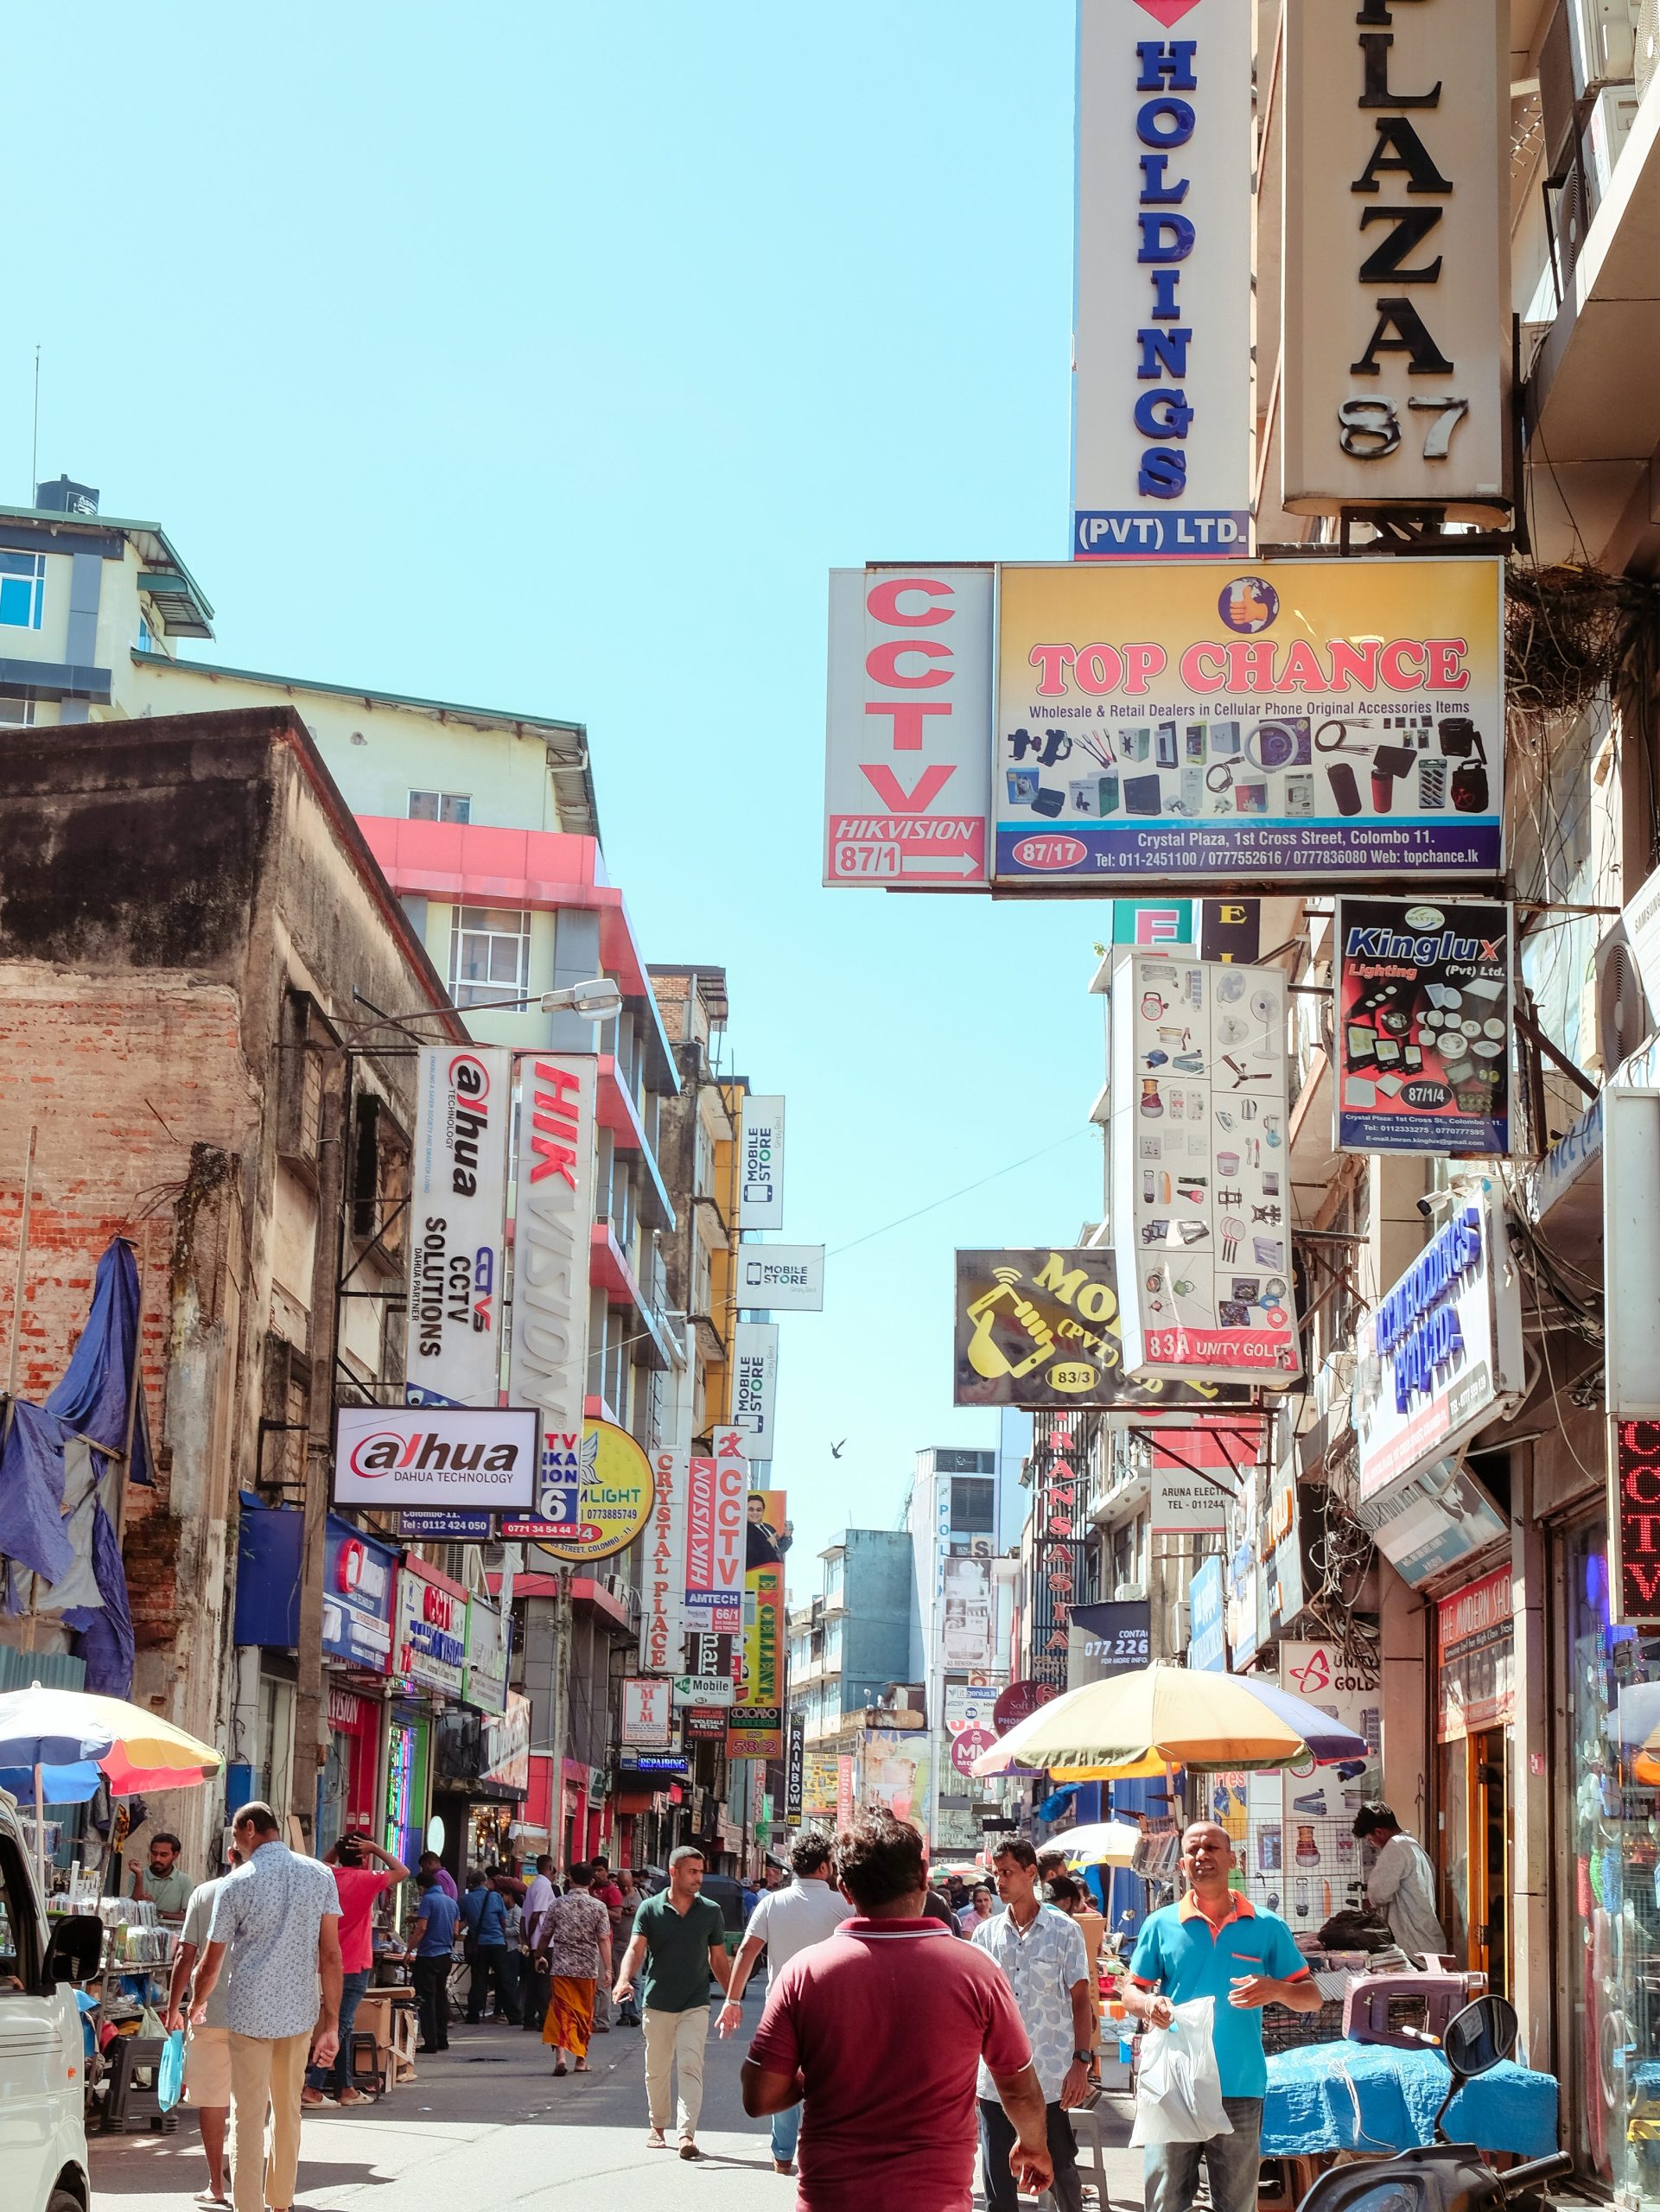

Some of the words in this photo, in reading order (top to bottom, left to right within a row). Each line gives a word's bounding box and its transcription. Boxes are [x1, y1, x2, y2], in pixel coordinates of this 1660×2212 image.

[1135, 41, 1197, 499] HOLDINGS
[1339, 395, 1468, 460] 87
[1079, 518, 1164, 550] (PVT)
[1177, 518, 1246, 543] LTD.
[1028, 643, 1167, 696] TOP
[1180, 639, 1471, 696] CHANCE
[859, 579, 957, 812] CCTV
[1029, 705, 1091, 718] Wholesale
[1097, 705, 1105, 717] &
[1110, 704, 1145, 717] Retail
[1149, 703, 1195, 716] Dealers
[1199, 703, 1210, 716] in
[1214, 702, 1260, 715] Cellular
[1265, 702, 1301, 715] Phone
[1307, 702, 1354, 716] Original
[1358, 701, 1431, 714] Accessories
[1436, 701, 1469, 713] Items
[835, 820, 975, 840] HIKVISION
[1137, 832, 1184, 849] Crystal
[1190, 832, 1230, 848] Plaza,
[1234, 831, 1254, 845] 1st
[1259, 830, 1296, 845] Cross
[1301, 830, 1345, 846] Street,
[1351, 830, 1409, 844] Colombo
[1414, 830, 1434, 844] 11.
[841, 847, 896, 872] 87/1
[1023, 842, 1076, 862] 87/17
[1095, 853, 1115, 867] Tel:
[1119, 852, 1196, 867] 011-2451100
[1208, 850, 1282, 865] 0777552616
[1294, 850, 1367, 865] 0777836080
[1371, 849, 1400, 863] Web:
[1404, 849, 1479, 866] topchance.lk
[1345, 927, 1506, 967] Kinglux
[1348, 963, 1417, 981] Lighting
[1446, 964, 1476, 977] (Pvt)
[1479, 966, 1504, 977] Ltd.
[1409, 1087, 1445, 1103] 87/1/4
[446, 1089, 456, 1150] TECHNOLOGY
[747, 1128, 758, 1181] MOBILE
[760, 1128, 772, 1181] STORE
[520, 1061, 580, 1415] HIKVISION
[413, 1248, 423, 1279] DAHUA
[419, 1217, 447, 1357] SOLUTIONS
[764, 1274, 807, 1284] STORE
[447, 1255, 472, 1324] CCTV
[411, 1281, 421, 1321] PARTNER
[1196, 1341, 1240, 1356] UNITY
[739, 1357, 750, 1411] MOBILE
[750, 1357, 763, 1411] STORE
[1058, 1371, 1091, 1383] 83/3
[394, 1471, 434, 1482] DAHUA
[438, 1471, 513, 1484] TECHNOLOGY
[1161, 1488, 1192, 1497] ARUNA
[587, 1509, 638, 1519] 0773885749
[652, 1455, 673, 1574] CRYSTAL
[1168, 1501, 1183, 1510] TEL
[403, 1520, 416, 1529] Tel
[423, 1521, 446, 1529] 0112
[448, 1521, 467, 1529] 424
[467, 1521, 487, 1530] 050
[690, 1461, 713, 1586] HIKVISION
[717, 1469, 741, 1586] CCTV
[588, 1535, 620, 1553] COLOMBO
[689, 1593, 739, 1605] AMTECH
[716, 1608, 739, 1620] 66/1
[1439, 1605, 1453, 1645] THE
[1456, 1585, 1490, 1639] MODERN
[651, 1582, 670, 1667] PLACE
[1119, 1630, 1148, 1638] CONTA
[758, 1574, 778, 1699] EXCELLENT
[1084, 1640, 1112, 1656] 077
[693, 1679, 728, 1691] Mobile
[1335, 1677, 1374, 1692] GOLD
[639, 1689, 654, 1722] MLM
[731, 1707, 778, 1719] COLOMBO
[1009, 1700, 1028, 1710] Soft
[731, 1739, 777, 1754] 58/2
[639, 1758, 685, 1769] REPAIRING
[790, 1730, 802, 1804] RAINBOW
